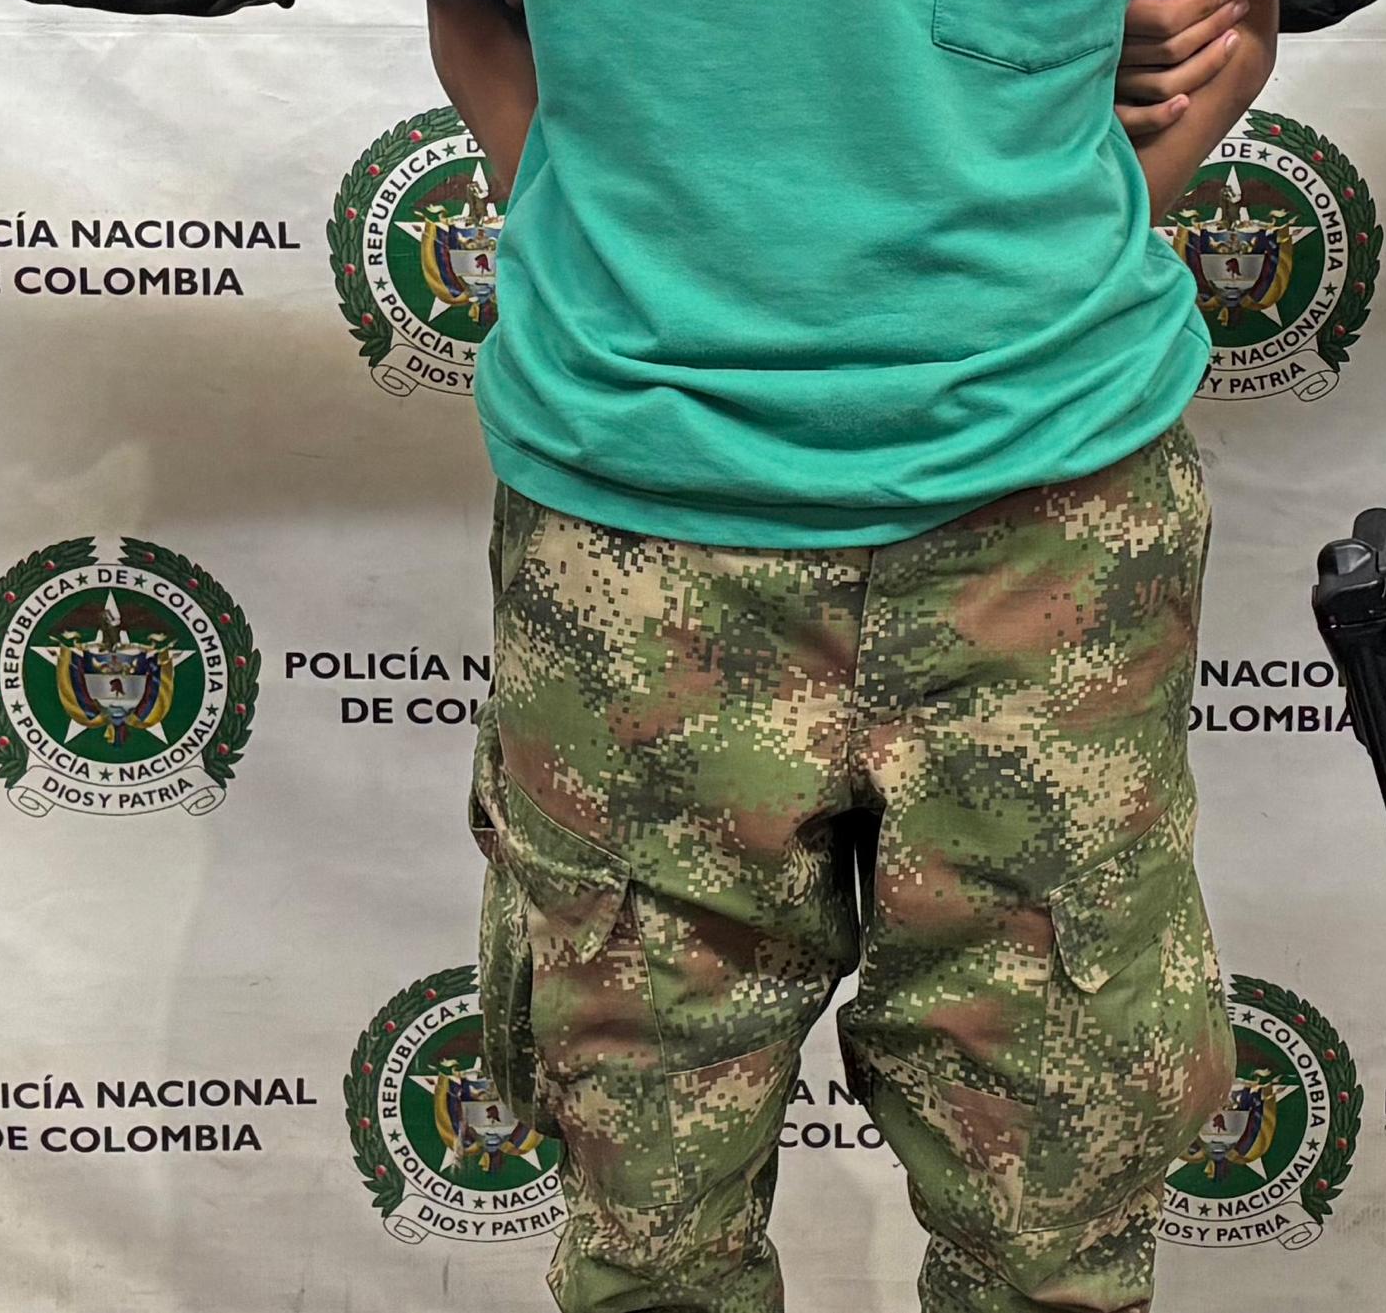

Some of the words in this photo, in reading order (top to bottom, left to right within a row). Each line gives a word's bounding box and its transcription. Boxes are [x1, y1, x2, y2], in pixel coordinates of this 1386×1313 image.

[1220, 142, 1251, 159] DE
[1276, 155, 1344, 272] COLOMBIA
[72, 220, 300, 249] NACIONAL
[14, 267, 243, 295] COLOMBIA
[1231, 299, 1333, 366] NACIONAL
[1229, 362, 1306, 393] PATRIA
[97, 568, 128, 584] DE
[153, 581, 224, 693] COLOMBIA
[286, 643, 450, 680] POLICÍA
[1201, 660, 1340, 688] NACIO
[341, 698, 393, 723] DE
[118, 719, 216, 782] NACIONAL
[118, 779, 193, 808] PATRIA
[98, 1078, 317, 1108] NACIONAL
[41, 1124, 261, 1152] COLOMBIA
